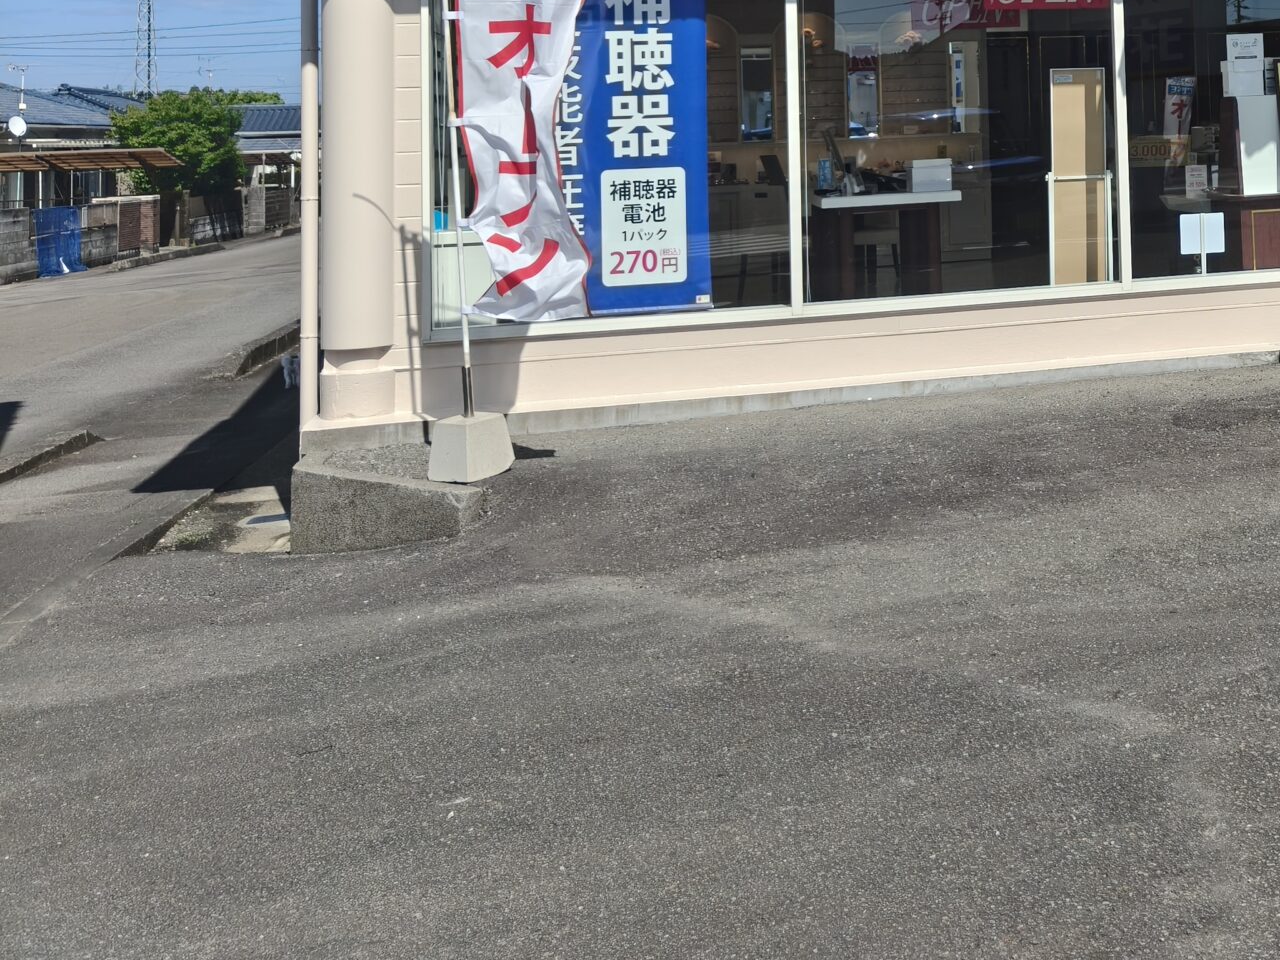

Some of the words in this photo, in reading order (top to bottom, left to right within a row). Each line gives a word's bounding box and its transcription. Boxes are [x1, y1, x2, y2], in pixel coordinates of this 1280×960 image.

[609, 179, 677, 201] 補聴器
[622, 202, 667, 224] 電池
[622, 228, 668, 242] 1パック
